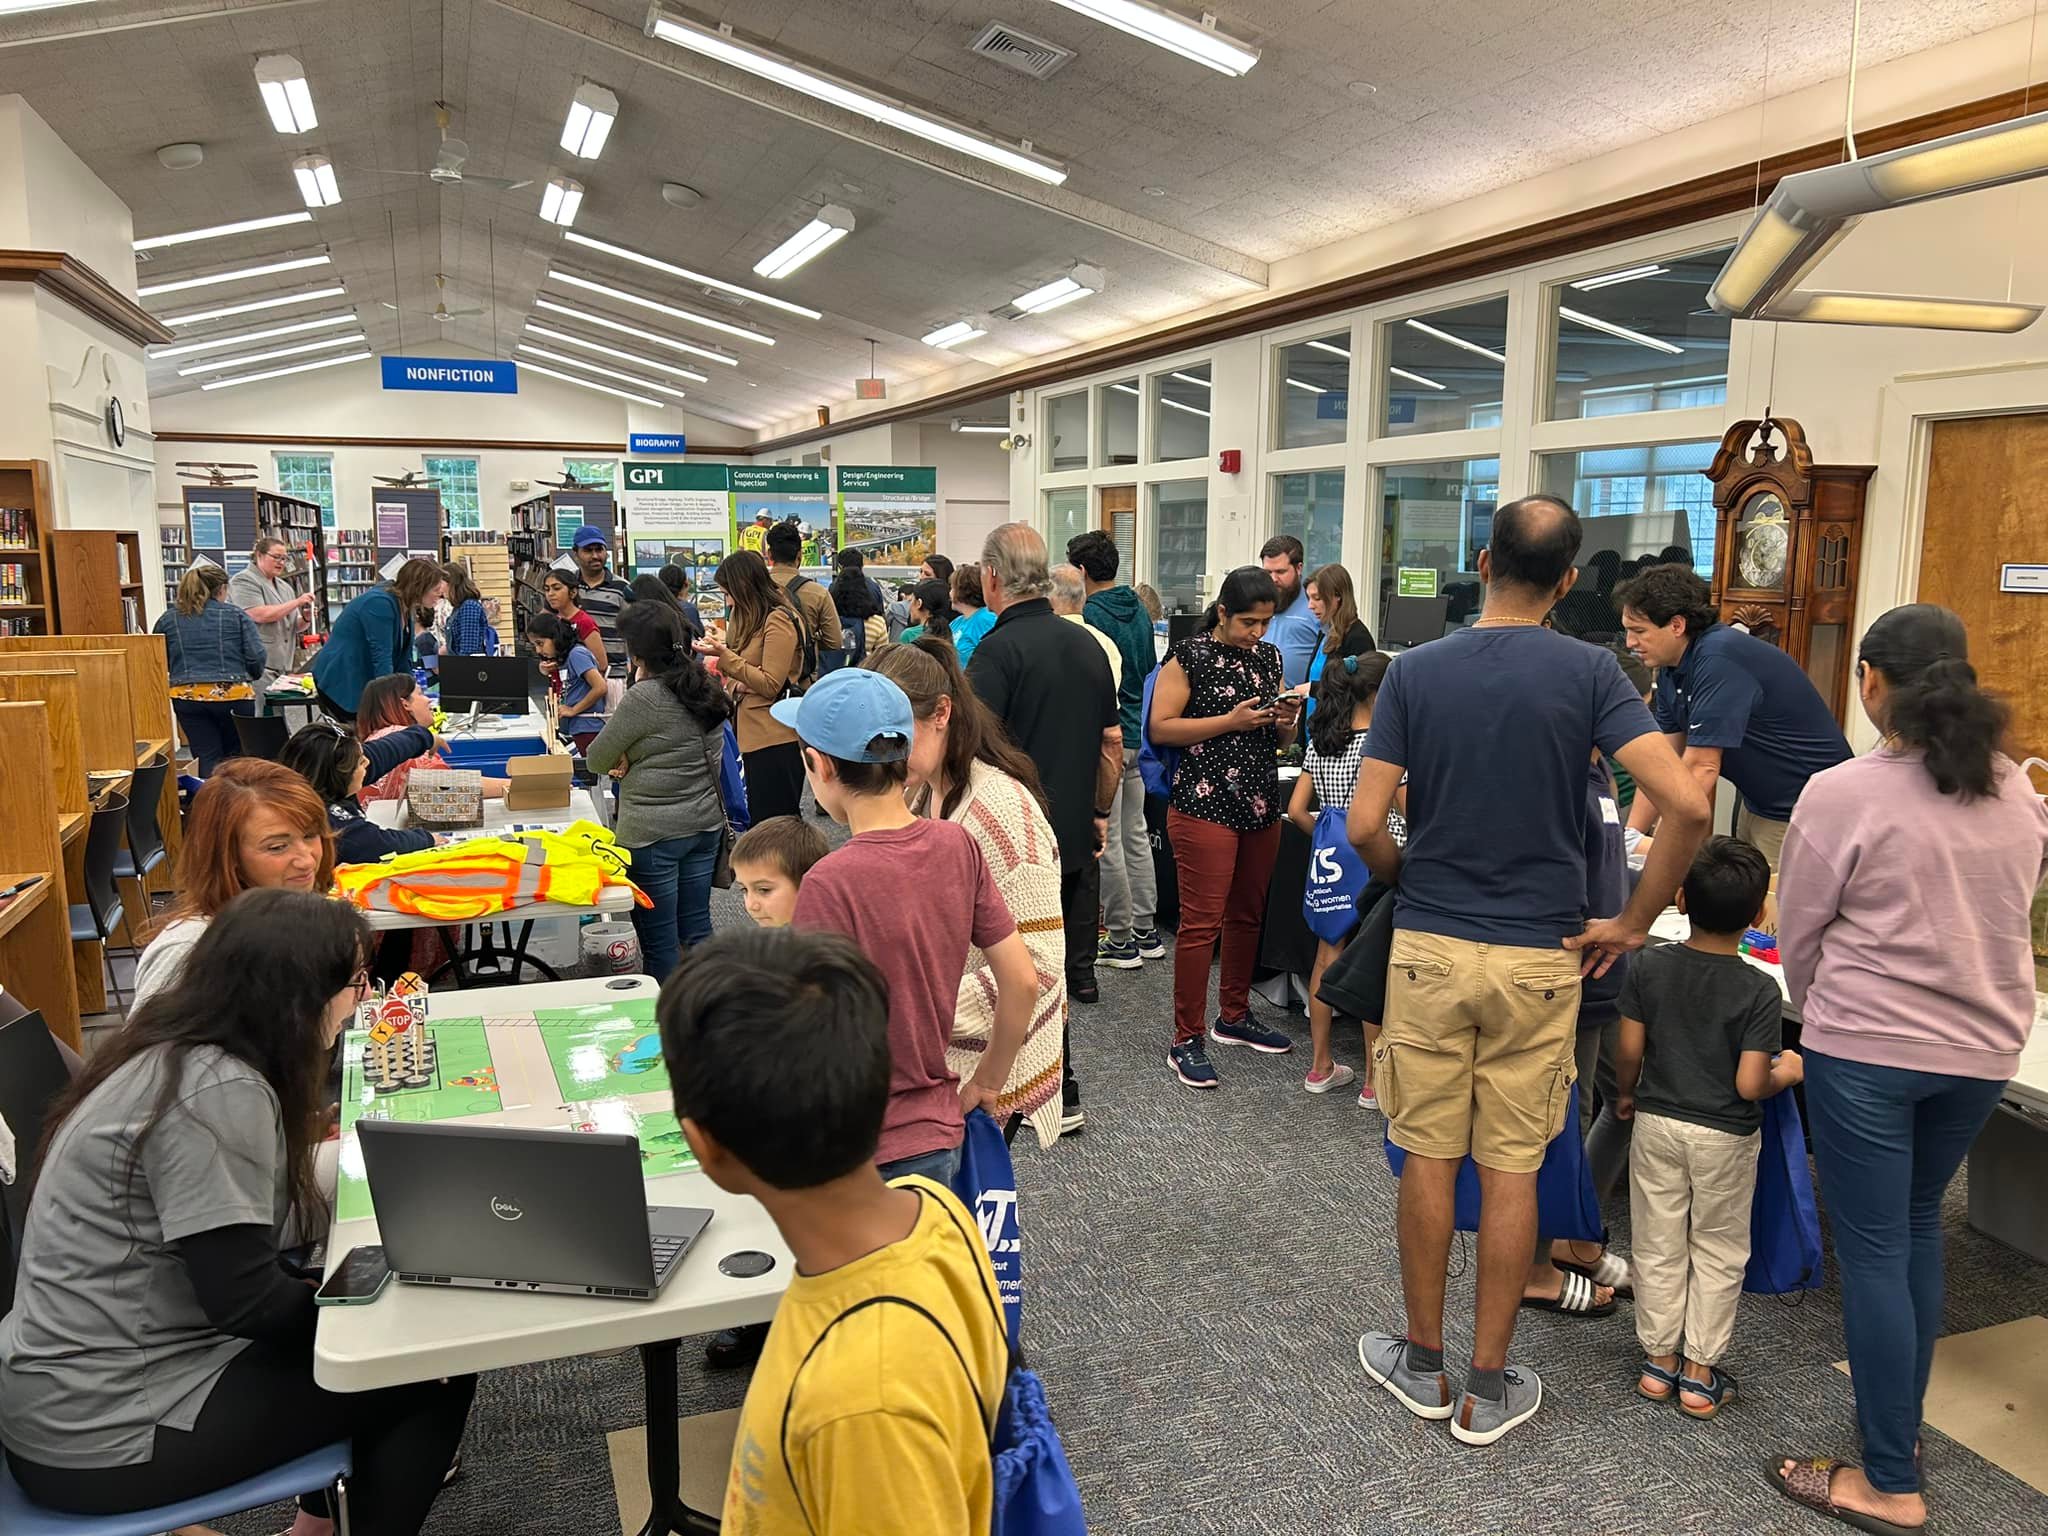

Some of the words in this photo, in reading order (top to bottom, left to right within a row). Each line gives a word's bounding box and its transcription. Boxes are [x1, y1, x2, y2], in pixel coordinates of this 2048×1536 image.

[406, 367, 494, 383] NONFICTION
[635, 438, 680, 448] BIOGRAPHY
[629, 469, 664, 484] GPI
[734, 471, 774, 479] Construction
[775, 471, 812, 481] Engineering
[842, 471, 904, 481] Design/Engineering
[882, 494, 931, 502] Structural/Bridge
[746, 529, 762, 539] GPI
[386, 1015, 411, 1026] STOP
